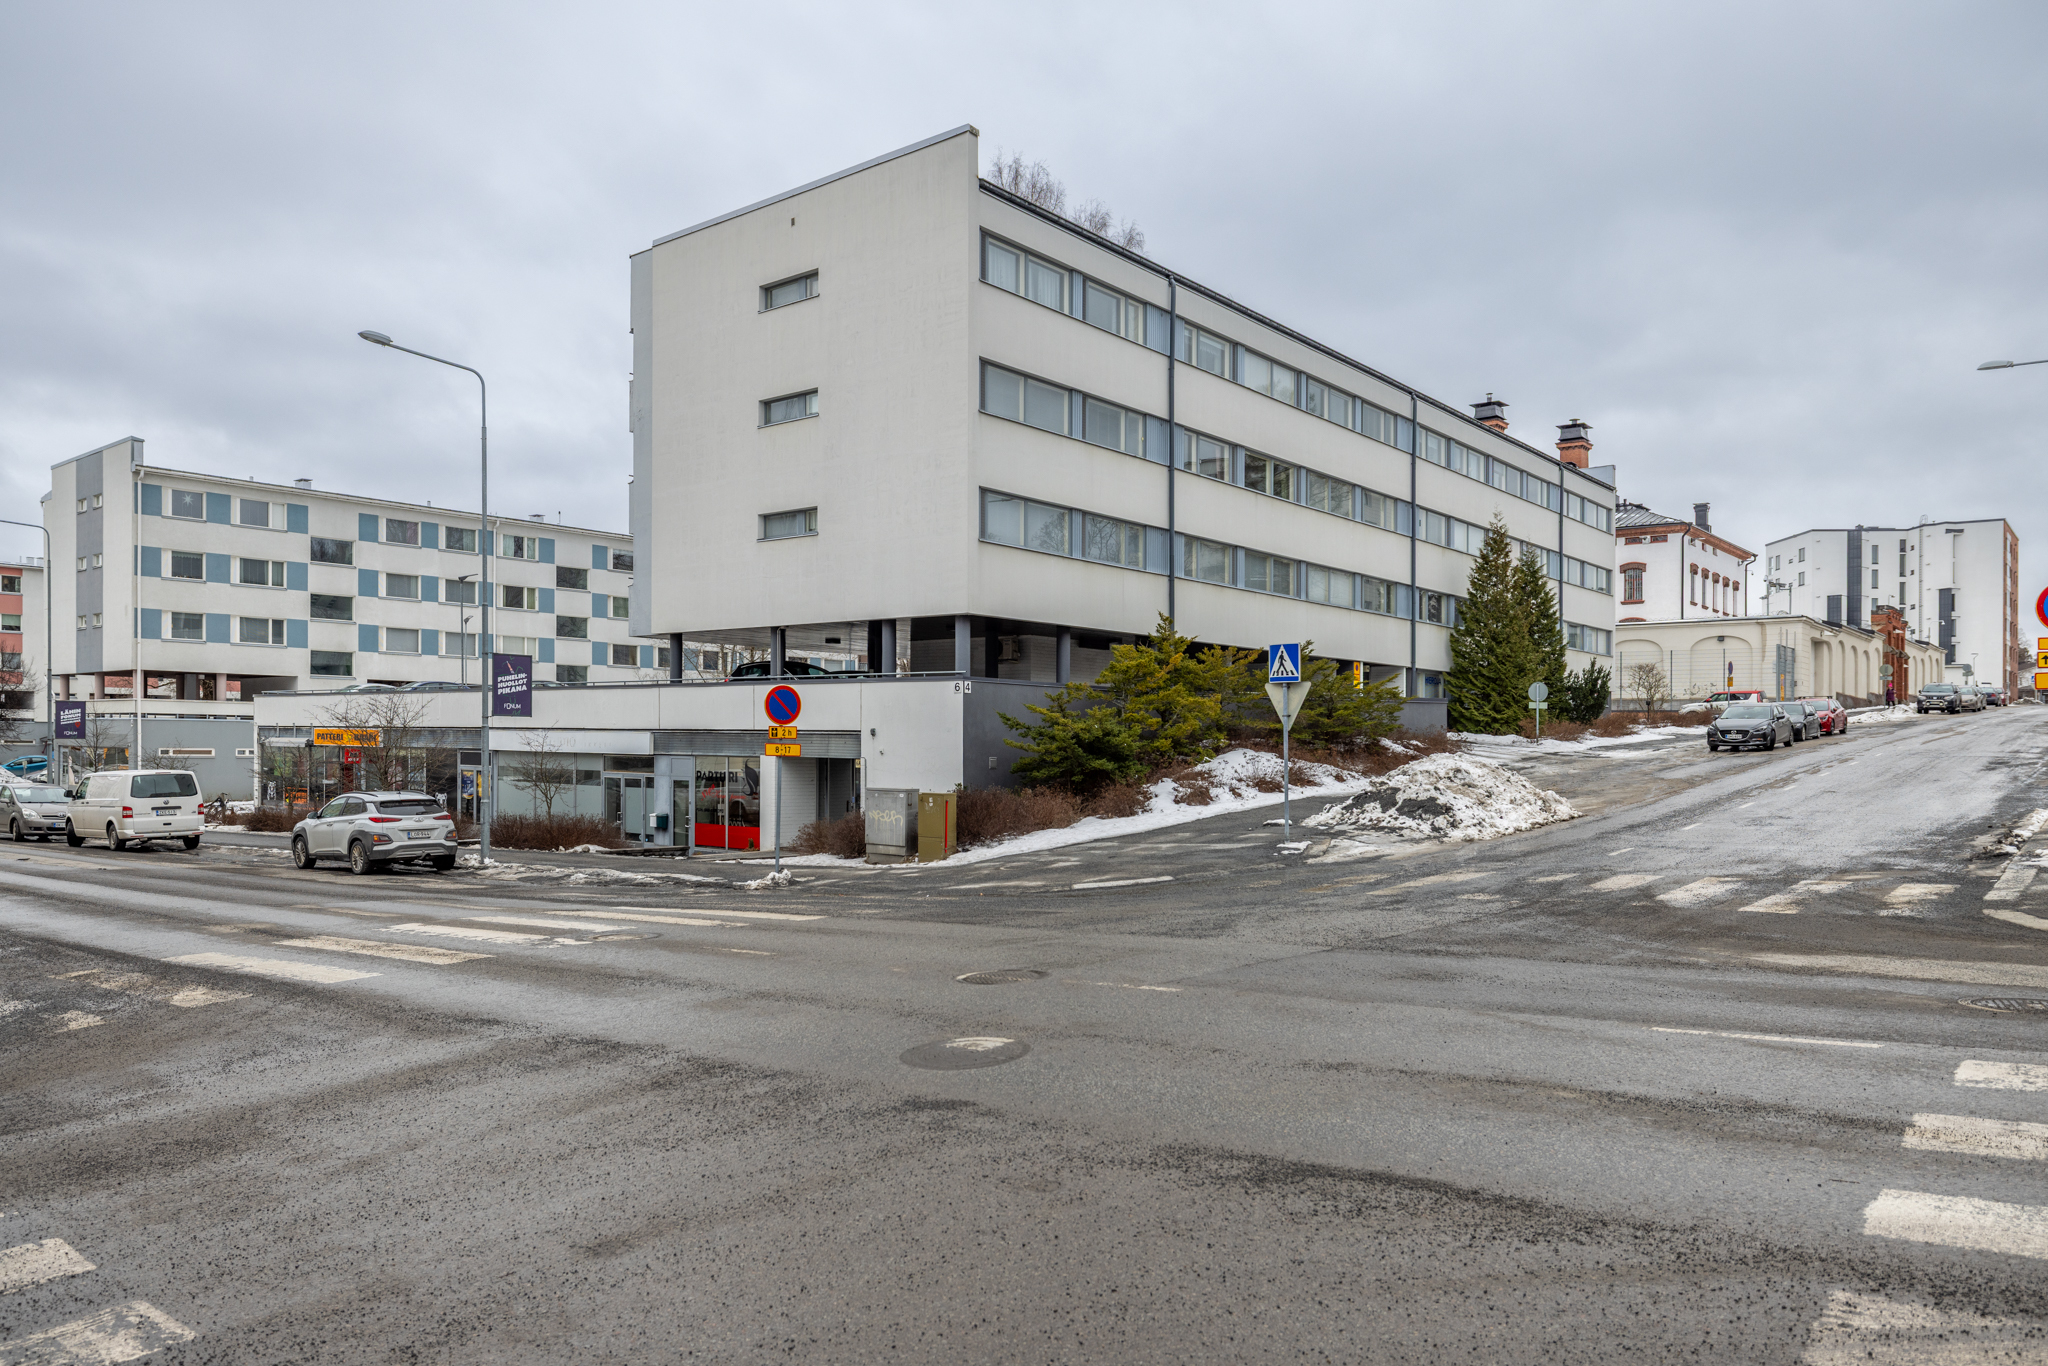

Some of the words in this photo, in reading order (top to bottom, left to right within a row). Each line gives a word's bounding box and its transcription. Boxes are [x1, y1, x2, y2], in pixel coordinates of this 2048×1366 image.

[498, 679, 528, 688] HUOLLOT
[955, 682, 960, 691] 6
[965, 682, 970, 691] 4
[498, 685, 528, 695] PIKANA
[696, 770, 738, 783] PARTURI
